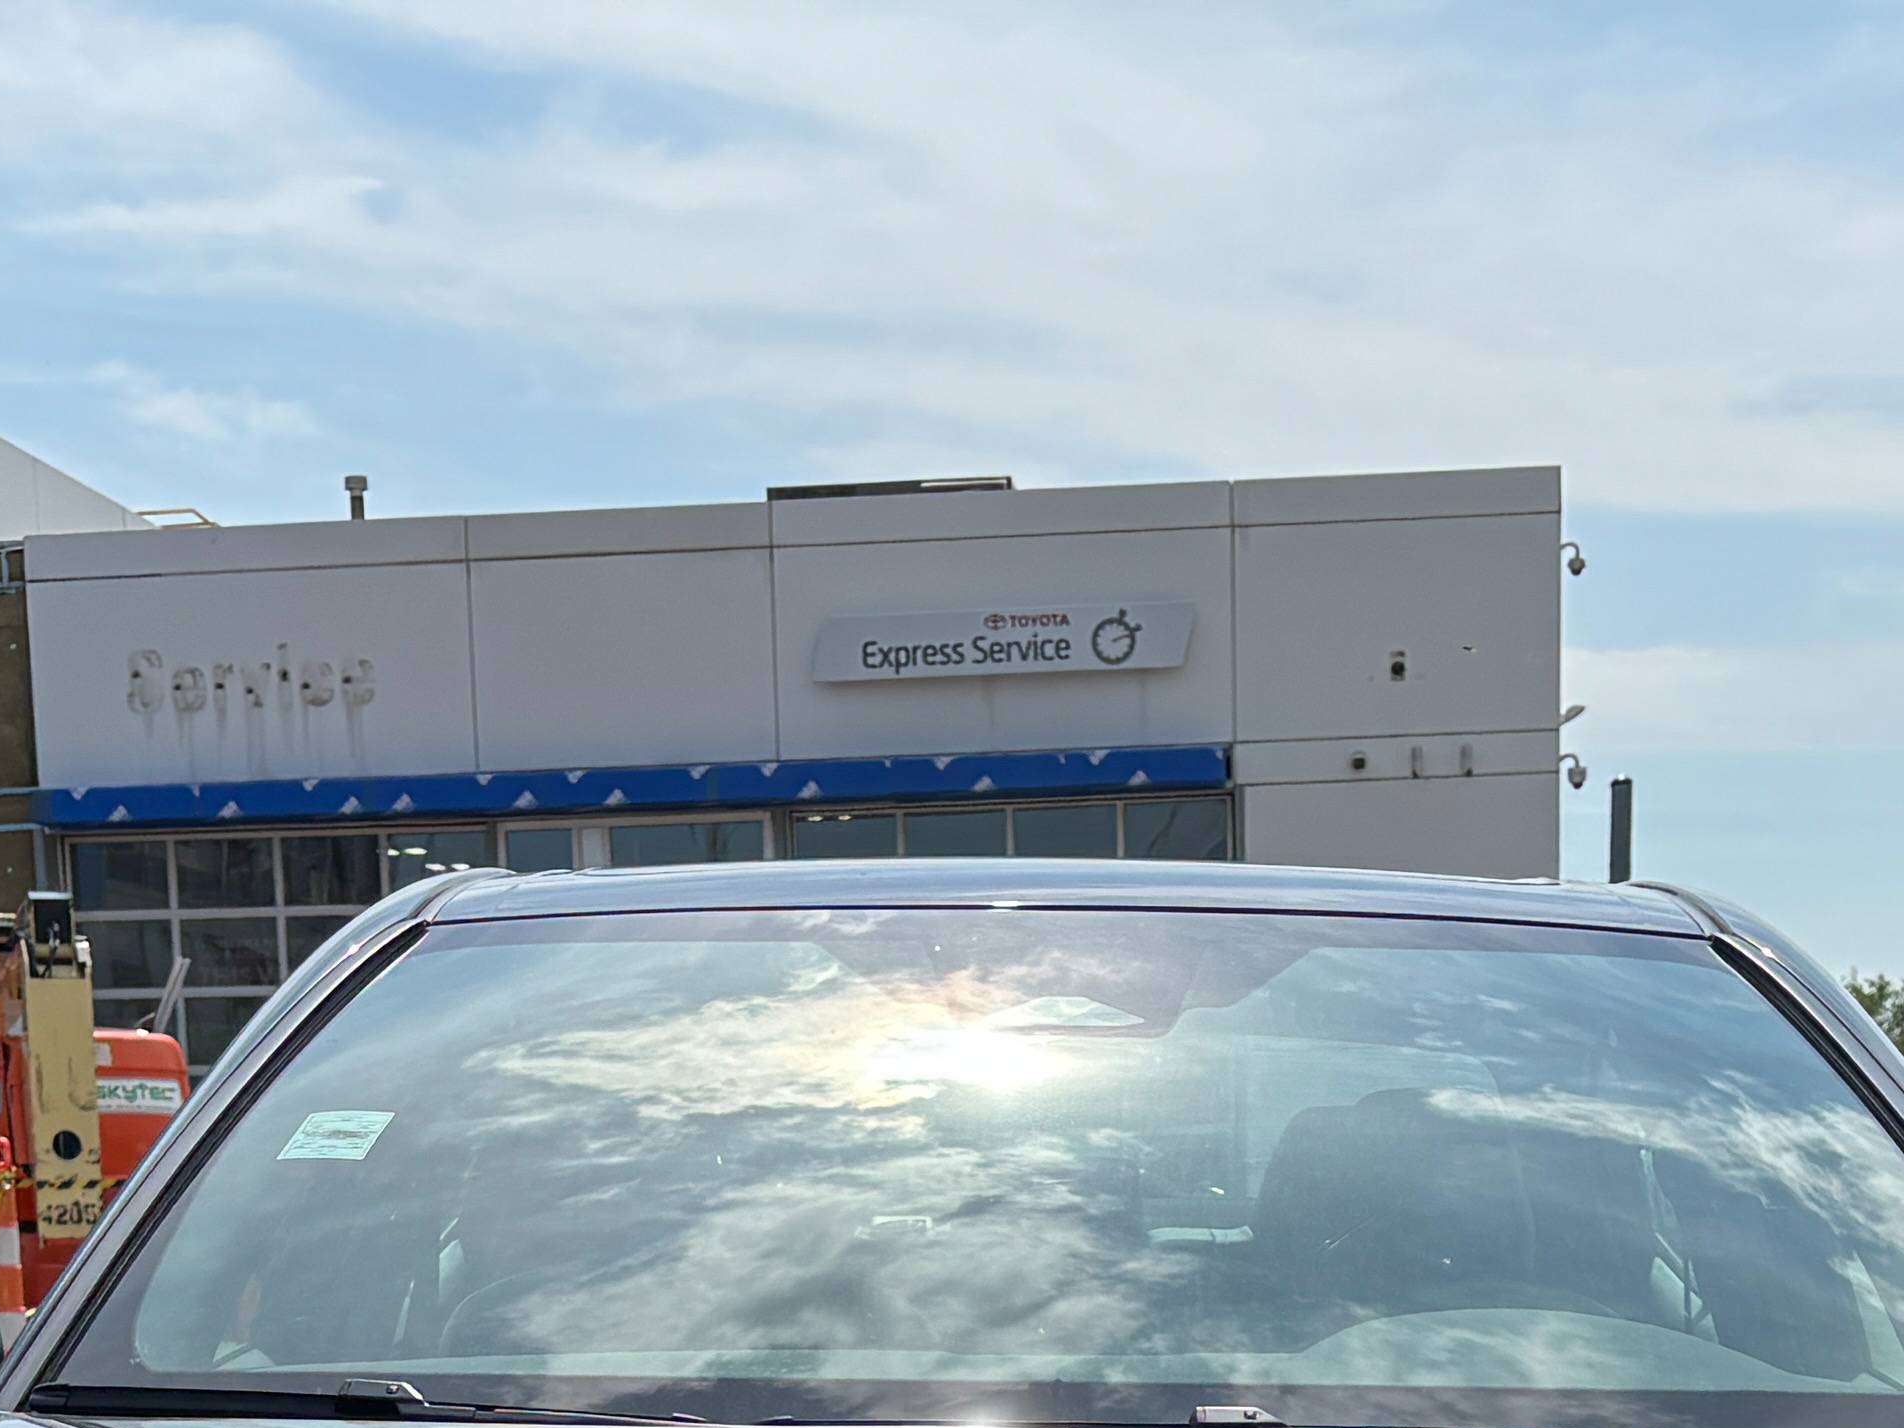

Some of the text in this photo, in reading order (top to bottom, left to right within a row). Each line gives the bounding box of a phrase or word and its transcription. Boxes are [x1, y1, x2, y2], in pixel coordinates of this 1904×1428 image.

[1008, 613, 1071, 629] TOYOTA
[861, 632, 1072, 676] Express Service
